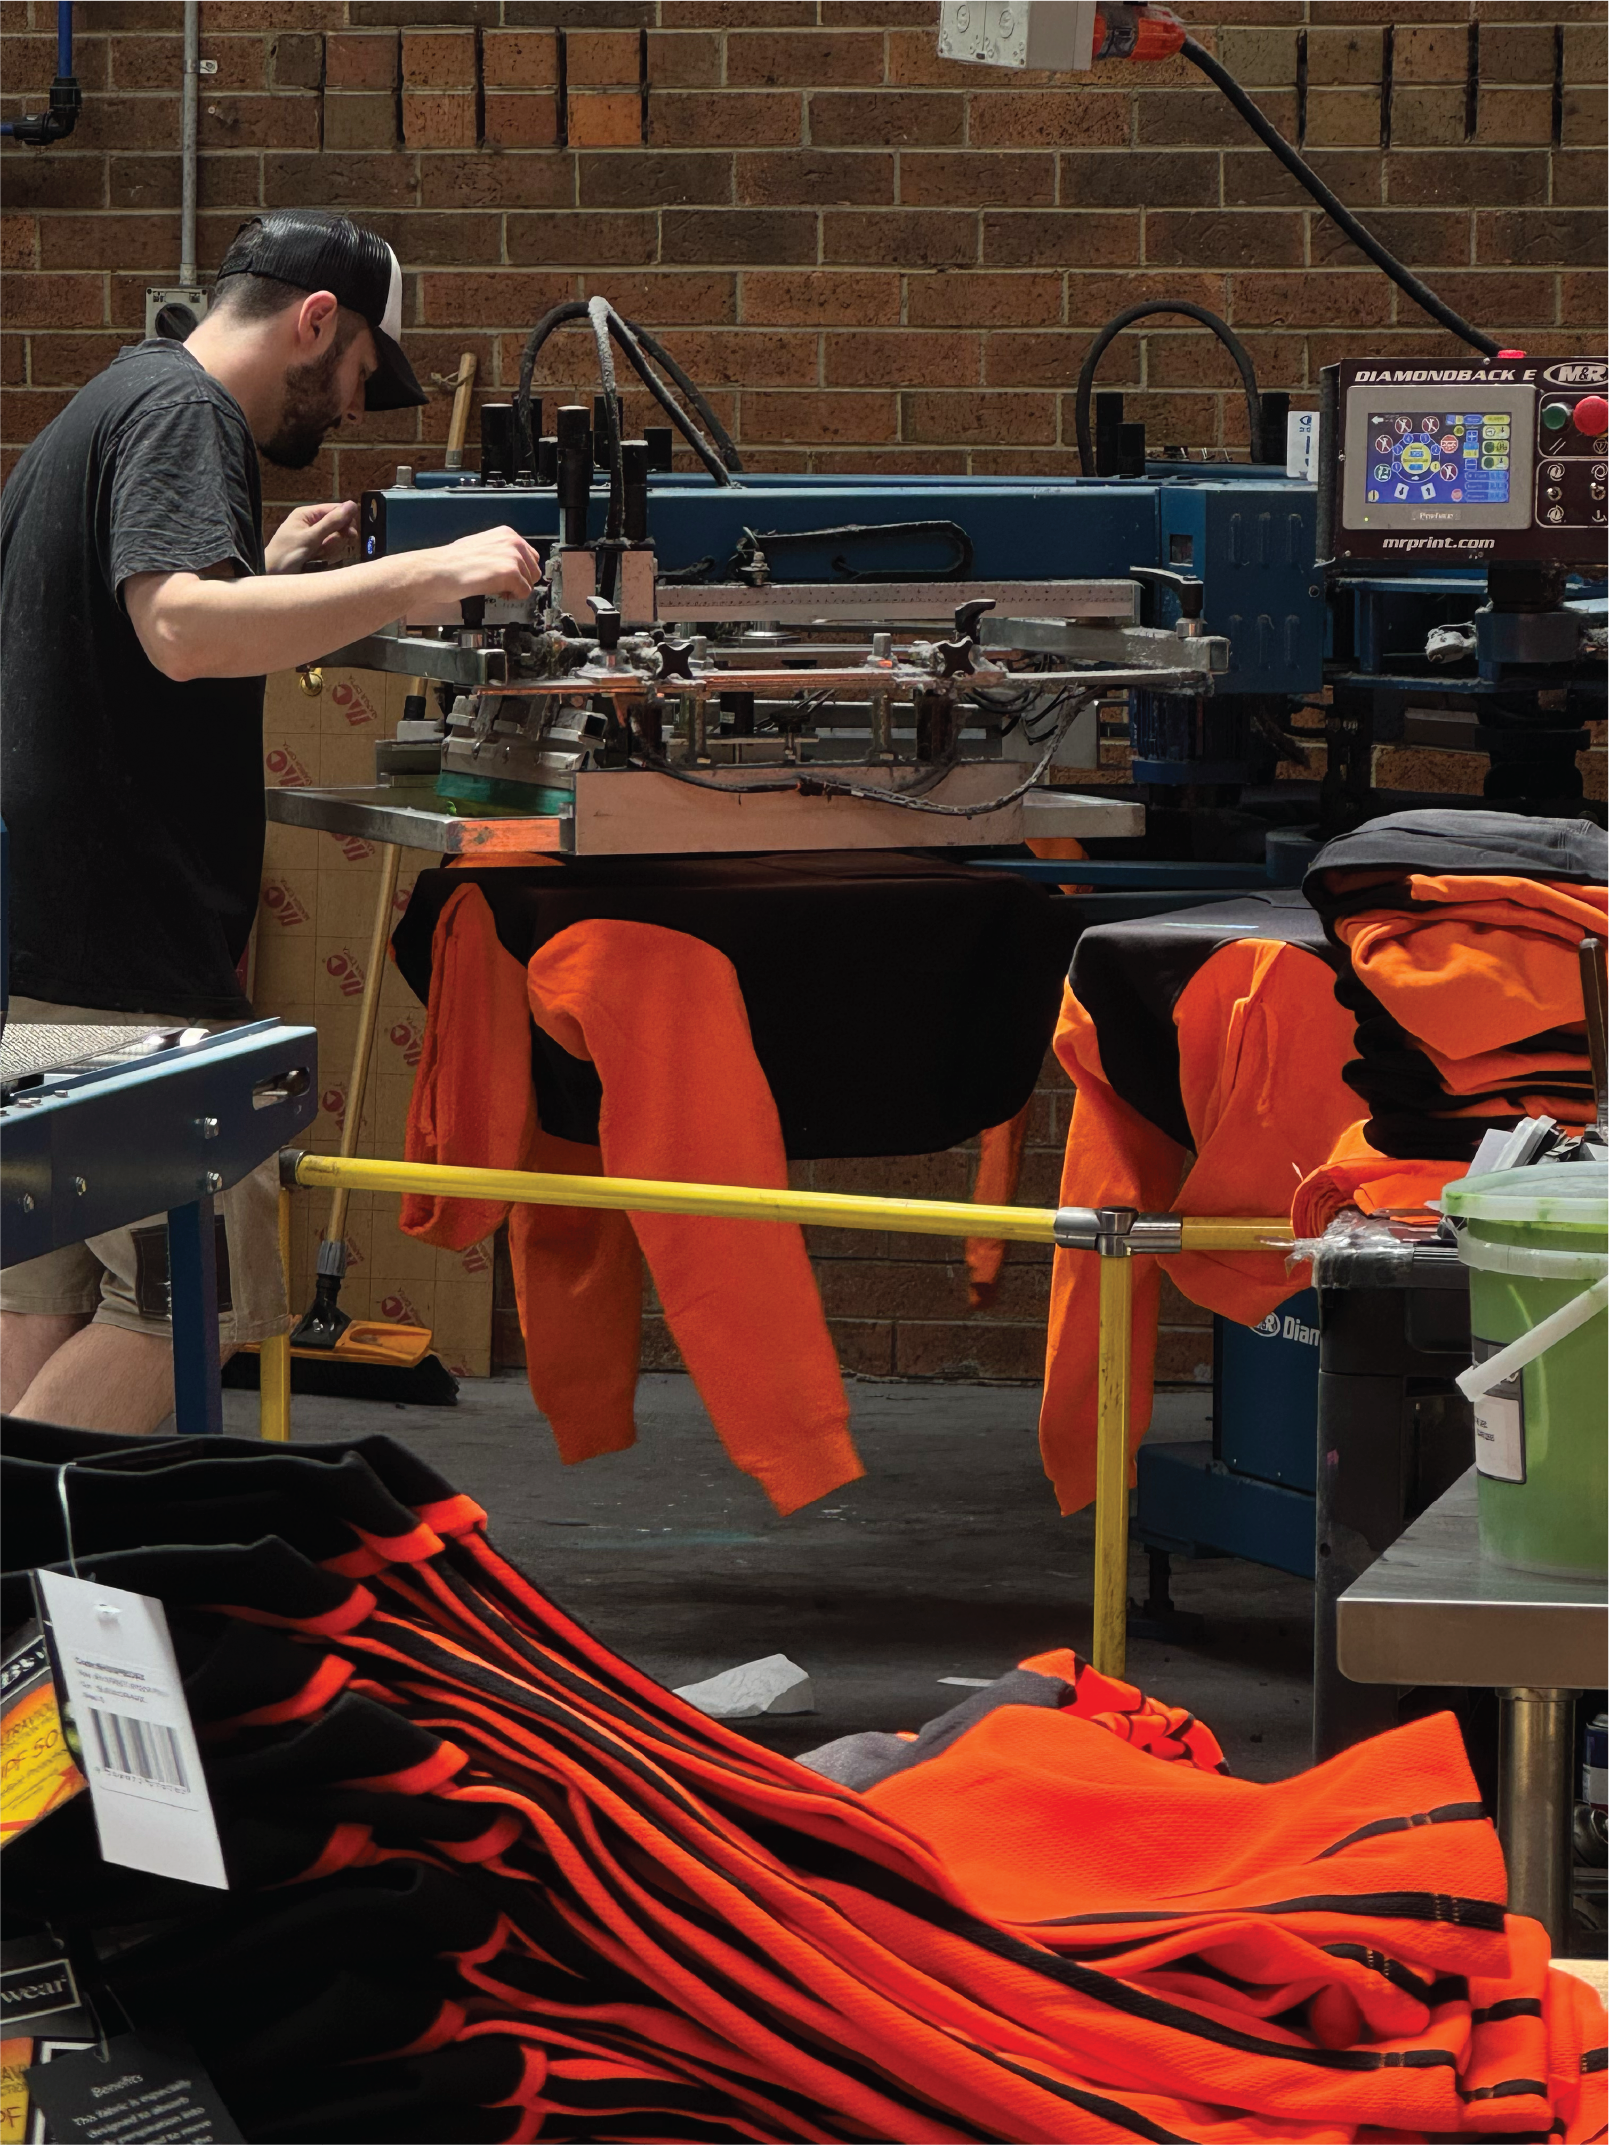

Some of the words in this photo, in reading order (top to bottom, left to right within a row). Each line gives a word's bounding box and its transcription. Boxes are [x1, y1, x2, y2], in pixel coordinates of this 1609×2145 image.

[1355, 369, 1516, 382] DIAMONDBACK
[1523, 369, 1538, 381] E
[1558, 365, 1607, 382] M&R
[1383, 536, 1495, 549] mrprint.com
[91, 2075, 143, 2097] Benefits
